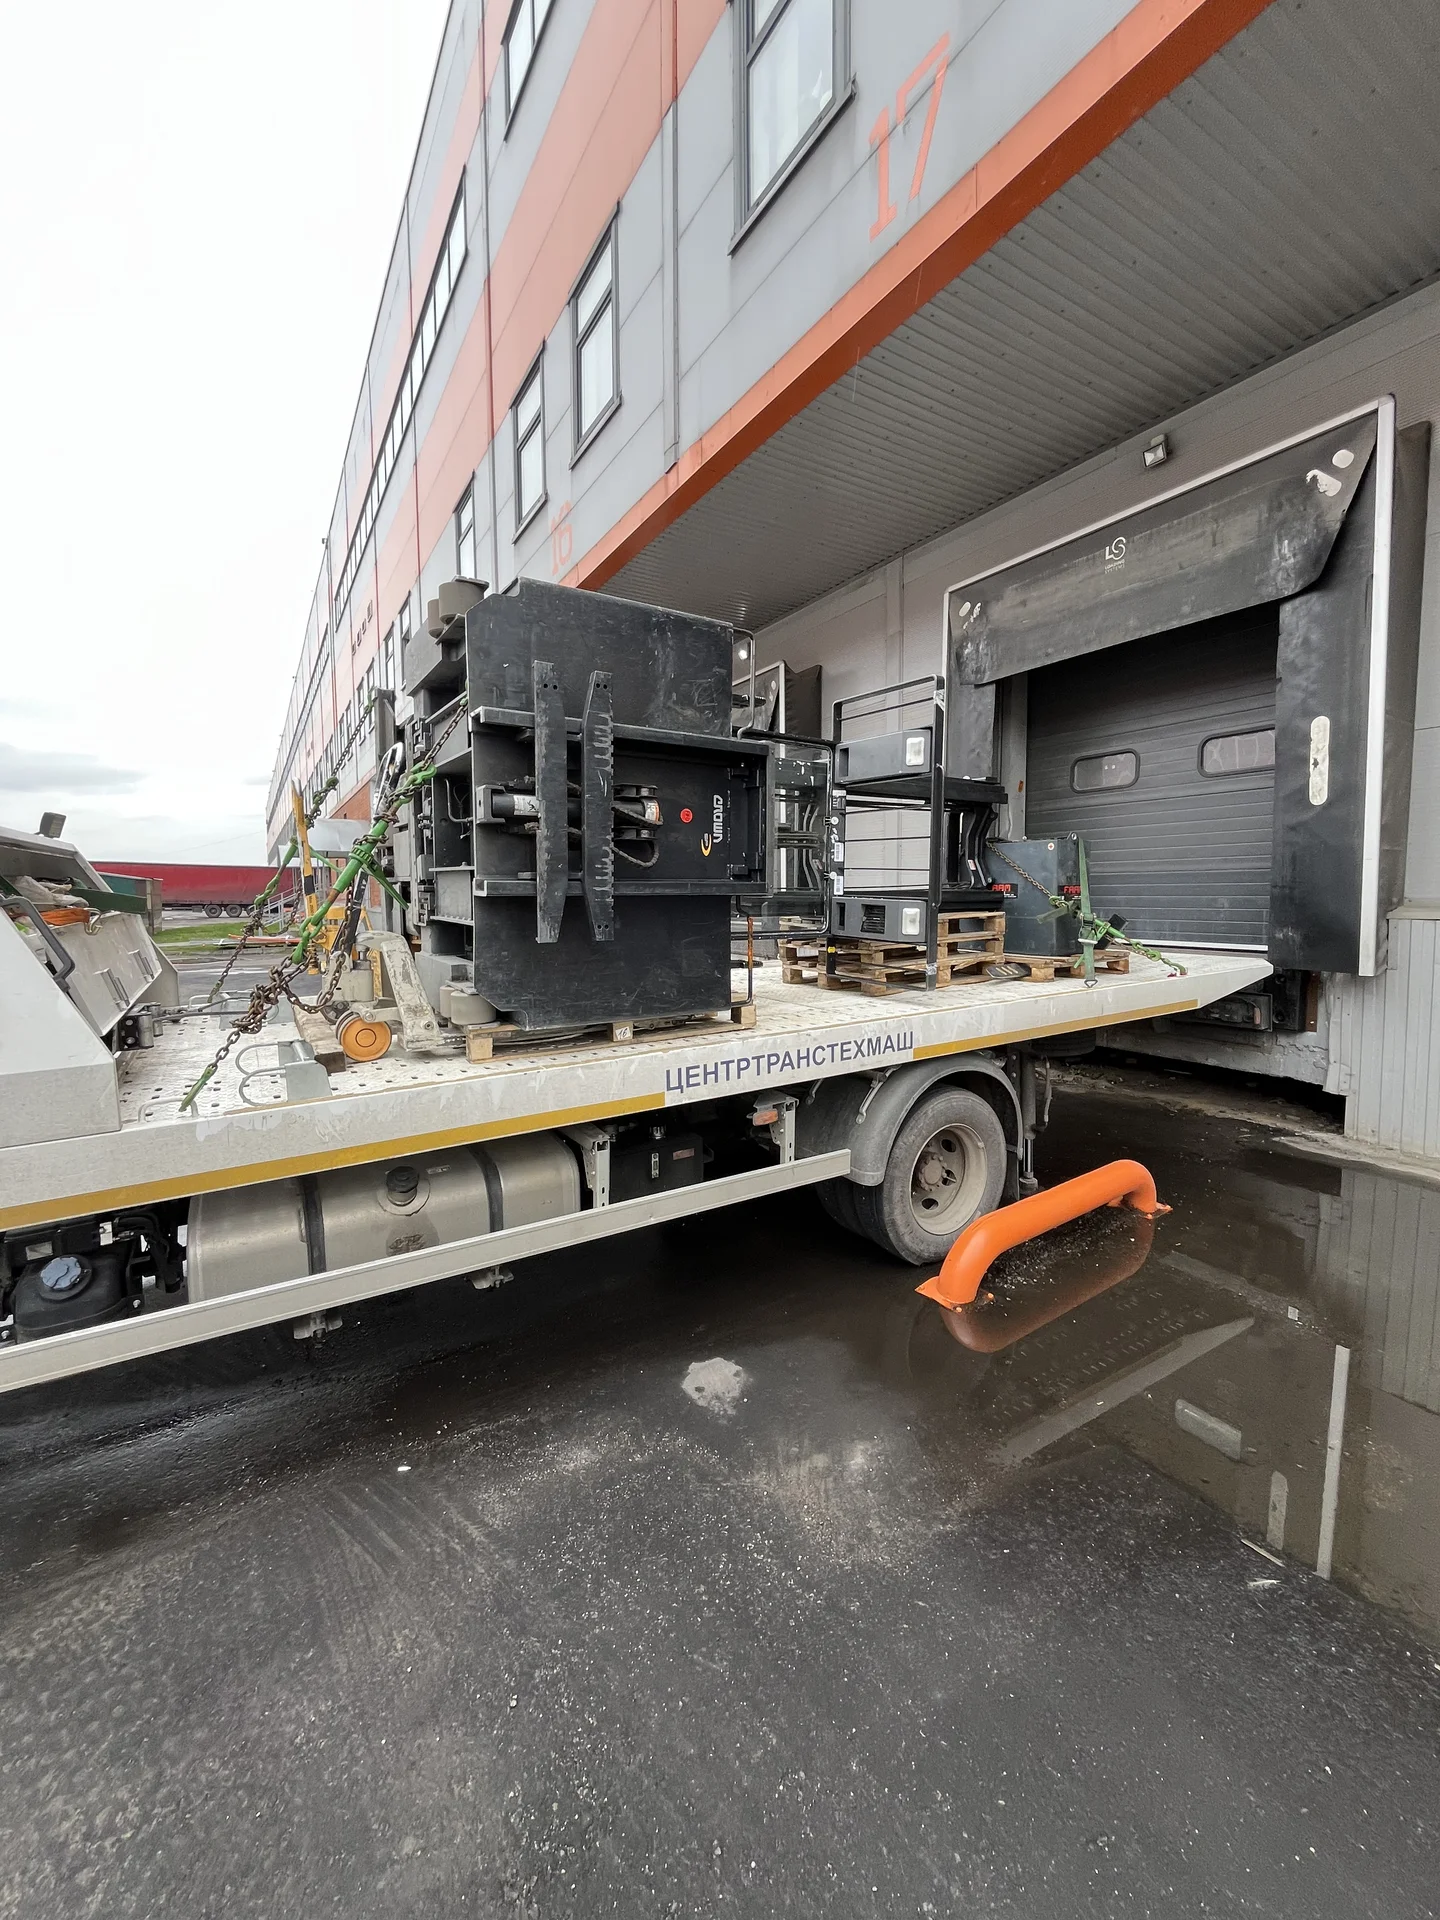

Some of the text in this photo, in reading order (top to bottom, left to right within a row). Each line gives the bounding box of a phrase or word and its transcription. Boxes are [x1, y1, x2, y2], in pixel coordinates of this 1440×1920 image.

[868, 31, 950, 243] 17
[1105, 536, 1126, 560] LS
[991, 884, 1011, 892] AAM
[1063, 885, 1081, 894] FAA
[665, 1031, 914, 1093] ЦЕНТРТРАНСТЕХМАШ
